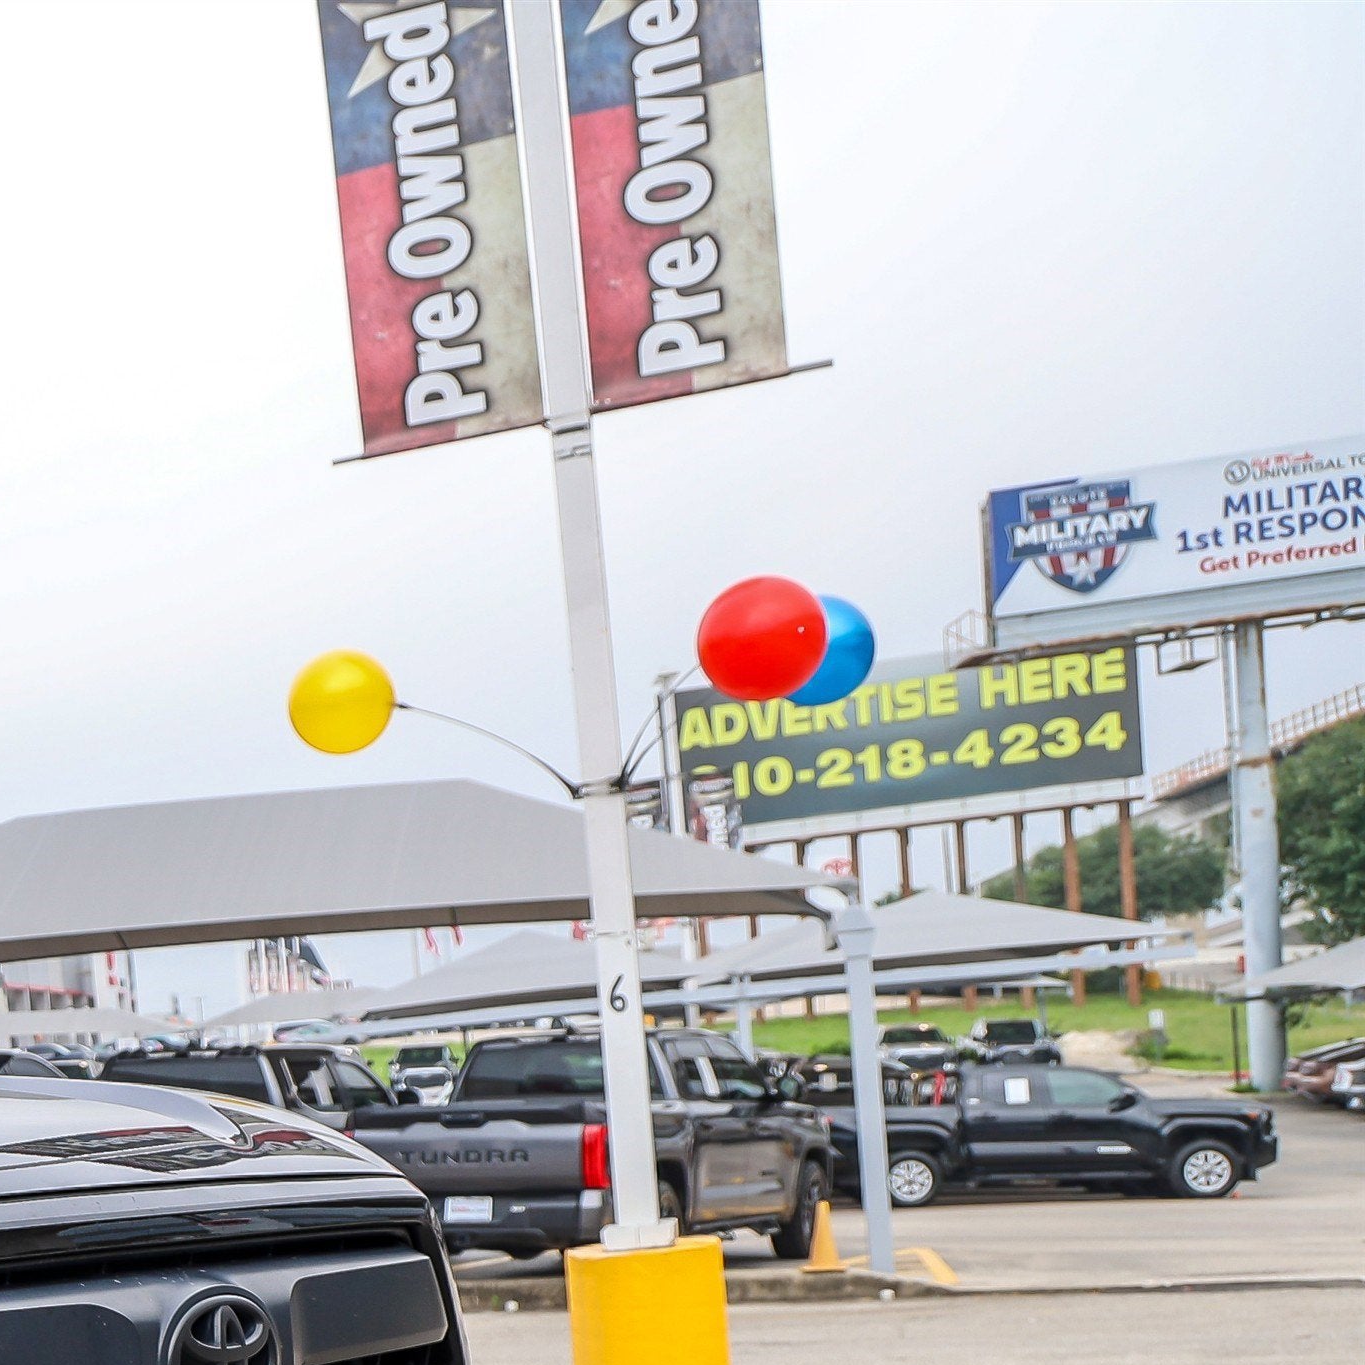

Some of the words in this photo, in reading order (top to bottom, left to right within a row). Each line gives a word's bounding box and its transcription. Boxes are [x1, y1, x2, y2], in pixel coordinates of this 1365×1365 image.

[363, 0, 475, 281] Owned
[637, 233, 726, 378] Pre
[405, 284, 489, 428] Pre
[1251, 457, 1346, 481] UNIVERSAL
[1222, 475, 1365, 519] MILITAR
[1013, 505, 1150, 548] MILITARY
[1176, 527, 1224, 553] 1st
[1199, 555, 1240, 574] Get
[1246, 536, 1357, 568] Preferred
[679, 671, 959, 752] ADVERTISE
[979, 646, 1127, 711] HERE
[690, 711, 1127, 800] 10-218-4234
[609, 973, 626, 1012] 6
[398, 1148, 531, 1166] TUNDRA
